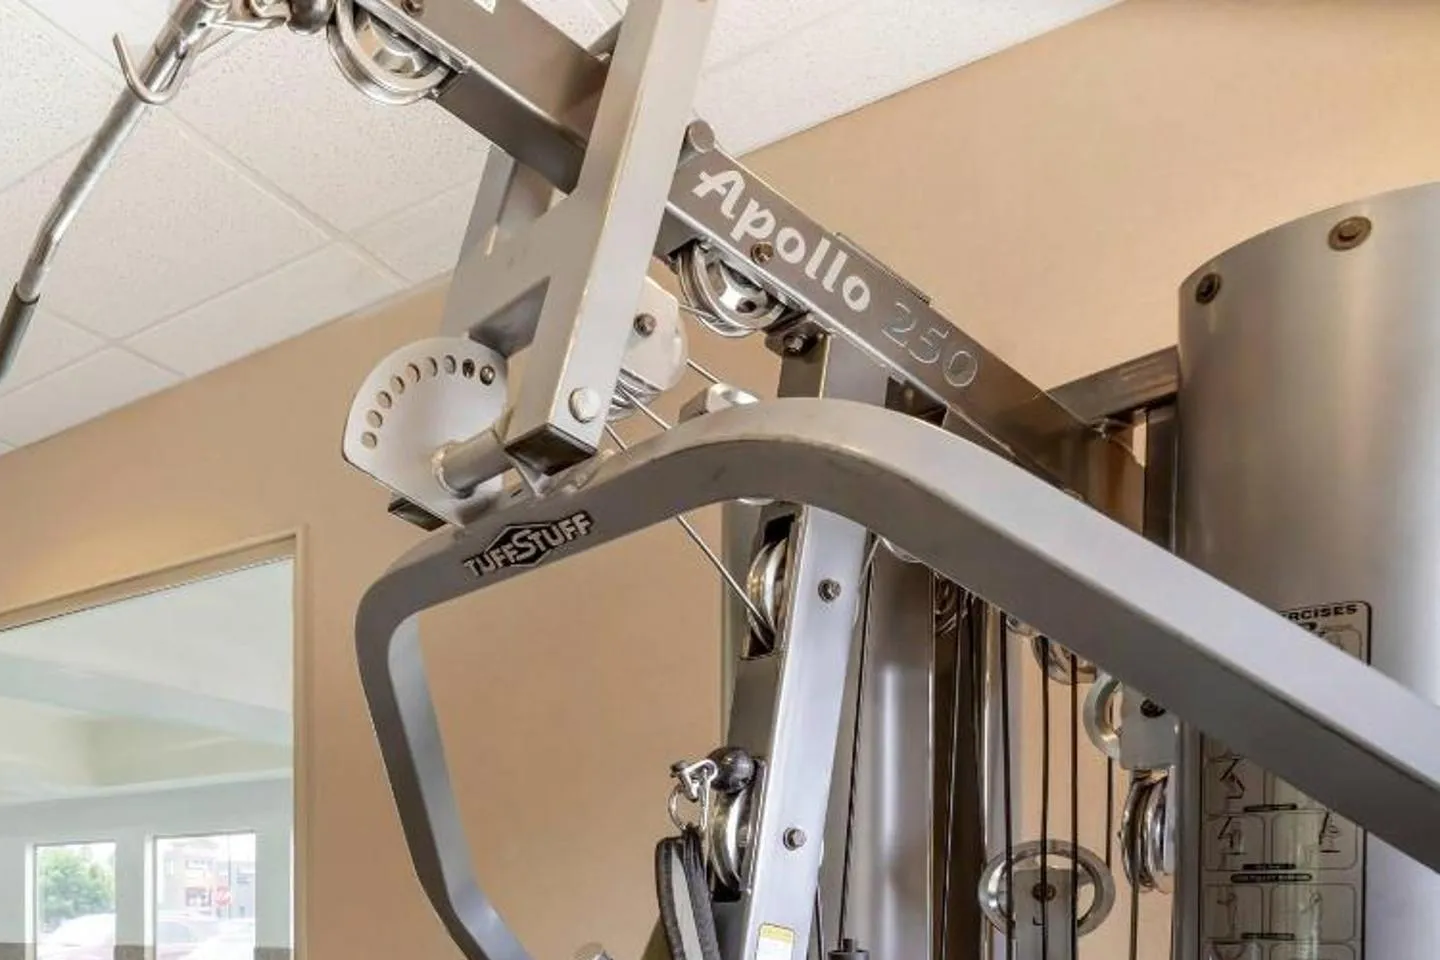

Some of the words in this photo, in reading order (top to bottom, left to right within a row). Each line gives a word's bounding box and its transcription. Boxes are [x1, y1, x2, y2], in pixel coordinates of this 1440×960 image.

[692, 170, 870, 313] Apollo
[881, 302, 978, 387] 250
[1282, 604, 1357, 621] RCISES
